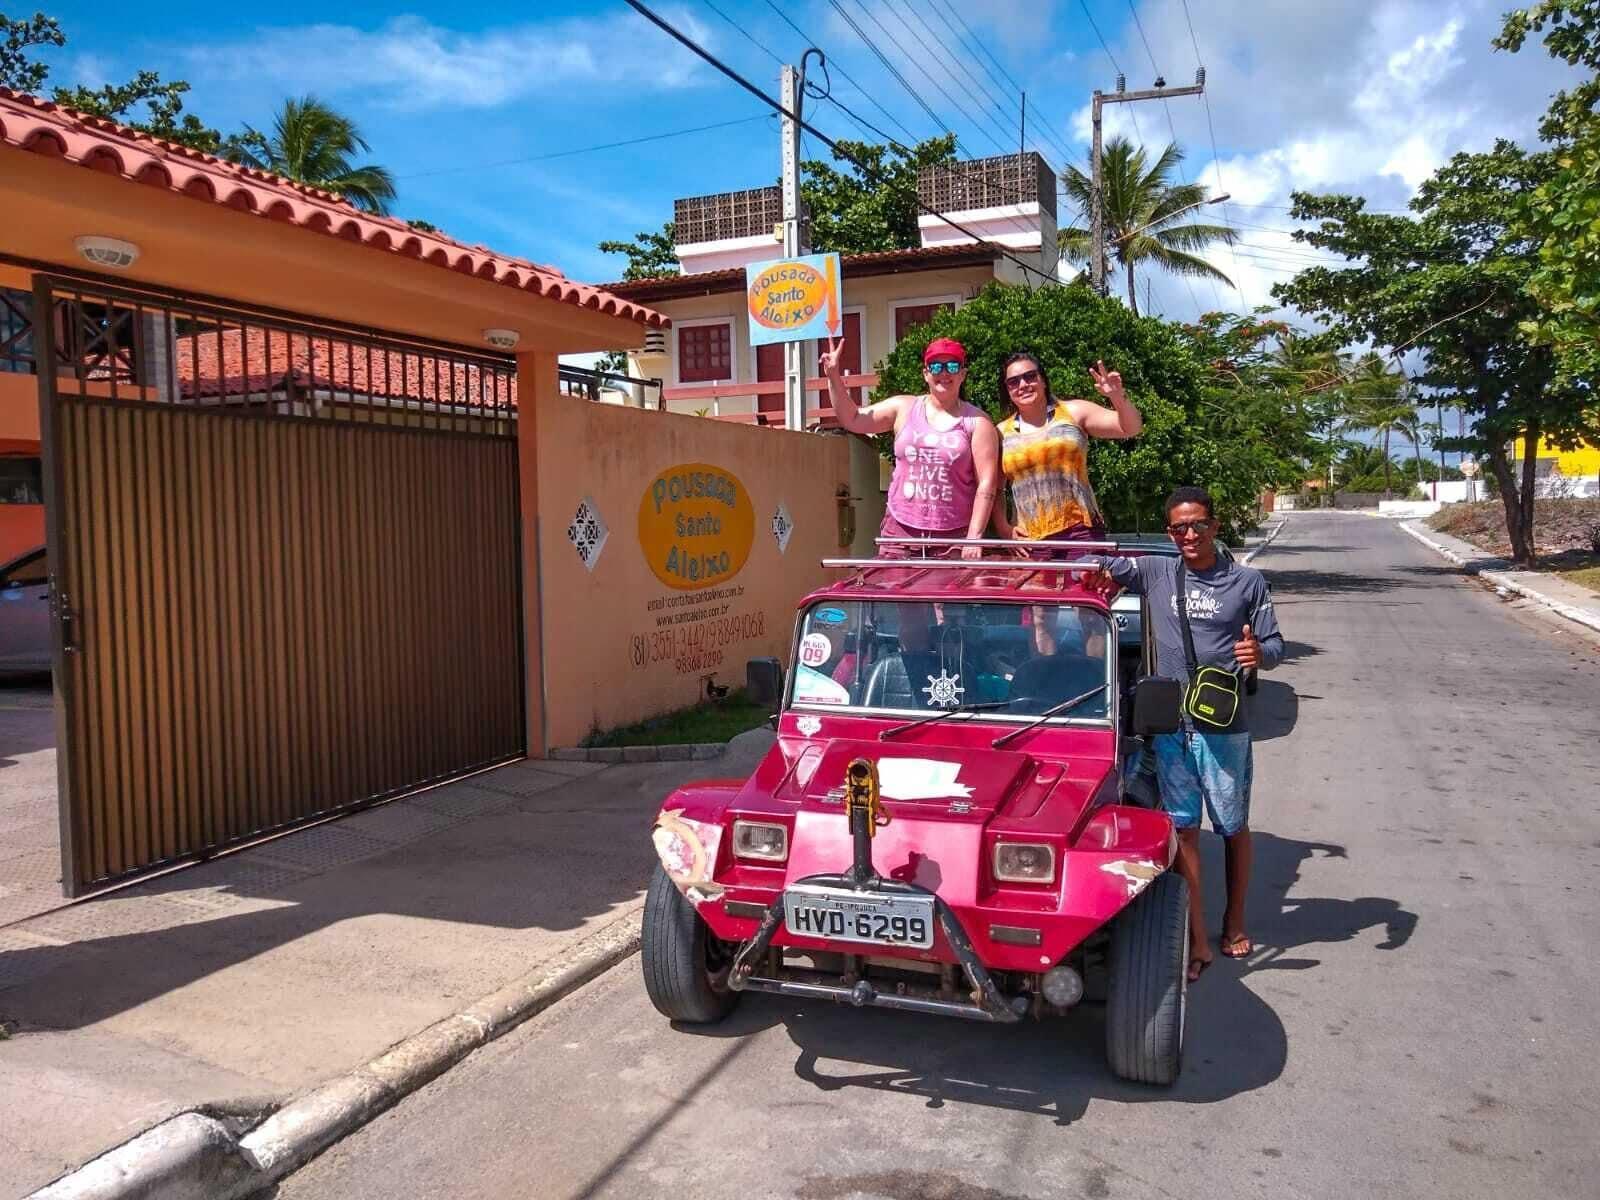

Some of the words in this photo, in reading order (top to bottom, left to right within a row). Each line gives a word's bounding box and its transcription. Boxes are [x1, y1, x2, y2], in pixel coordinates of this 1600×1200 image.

[767, 287, 805, 305] Santo
[760, 305, 814, 324] Aleixo
[912, 431, 961, 449] YOU
[904, 445, 960, 466] ONLY
[909, 465, 949, 483] LIVE
[903, 481, 953, 501] ONCE
[675, 511, 721, 537] Santo
[665, 545, 730, 581] Aleixo
[803, 648, 823, 662] 09
